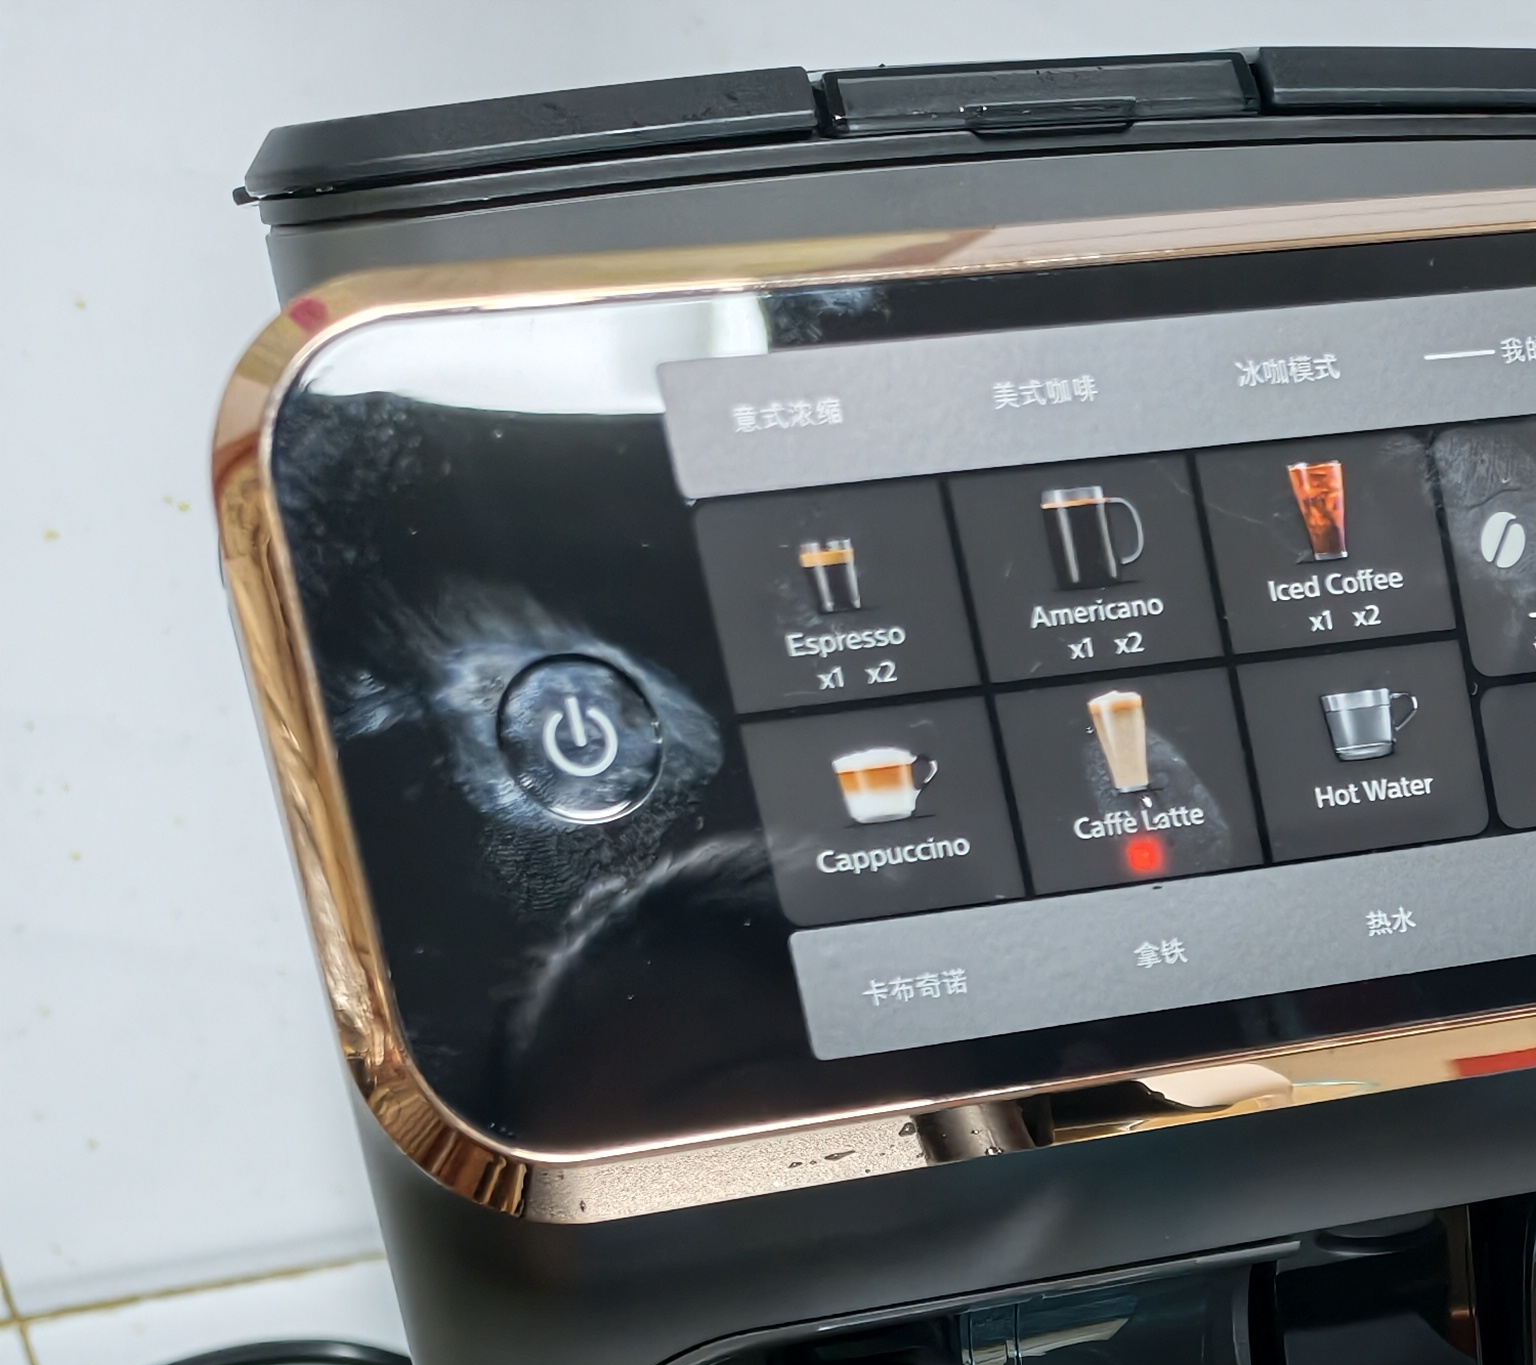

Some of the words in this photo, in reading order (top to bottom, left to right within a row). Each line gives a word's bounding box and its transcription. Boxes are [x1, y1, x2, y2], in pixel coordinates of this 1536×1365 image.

[1234, 353, 1341, 387] 冰咖模式
[992, 374, 1098, 410] 美式咖啡
[732, 396, 843, 433] 意式浓缩
[1267, 574, 1321, 602] Iced
[1325, 568, 1404, 595] Coffee
[1031, 598, 1164, 629] Americano
[1308, 609, 1333, 632] x1
[1351, 604, 1382, 627] x2
[785, 626, 906, 658] Espresso
[1067, 637, 1094, 660] x1
[1113, 631, 1145, 655] x2
[817, 666, 845, 690] x1
[864, 660, 898, 685] x2
[1314, 783, 1361, 809] Hot
[1361, 776, 1434, 802] Water
[1073, 810, 1138, 840] Caffè
[1140, 804, 1204, 831] Latte
[816, 837, 971, 875] Cappuccino
[1365, 906, 1417, 937] 热水
[1133, 937, 1189, 969] 拿铁
[862, 967, 968, 1007] 卡布奇诺
